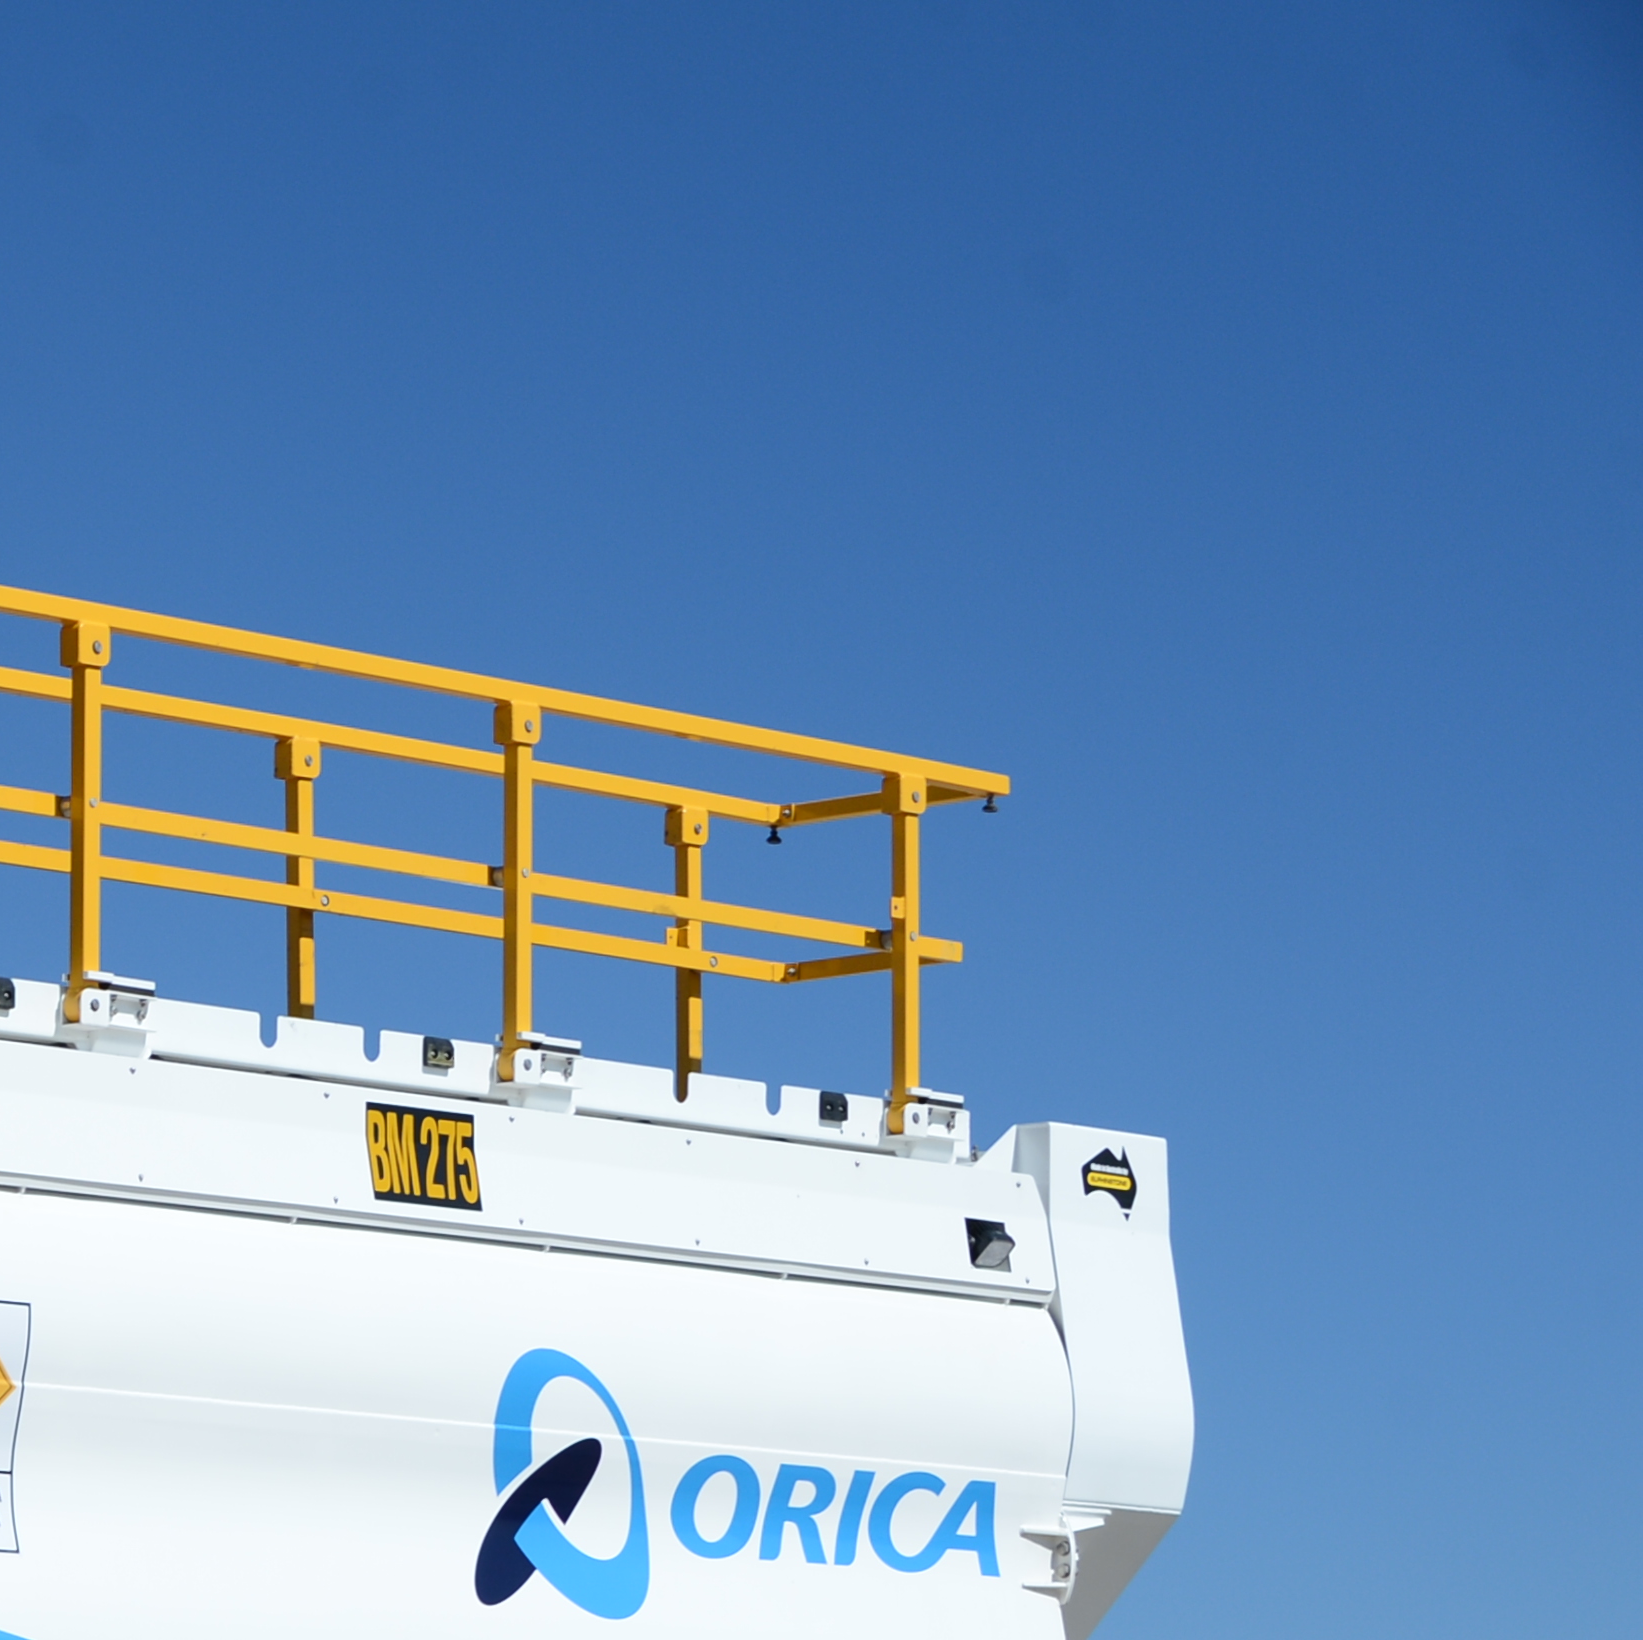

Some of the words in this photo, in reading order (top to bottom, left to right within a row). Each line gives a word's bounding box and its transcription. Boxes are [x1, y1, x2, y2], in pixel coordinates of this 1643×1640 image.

[367, 1109, 421, 1197] BM
[420, 1116, 479, 1204] 275
[670, 1454, 1001, 1577] ORICA
